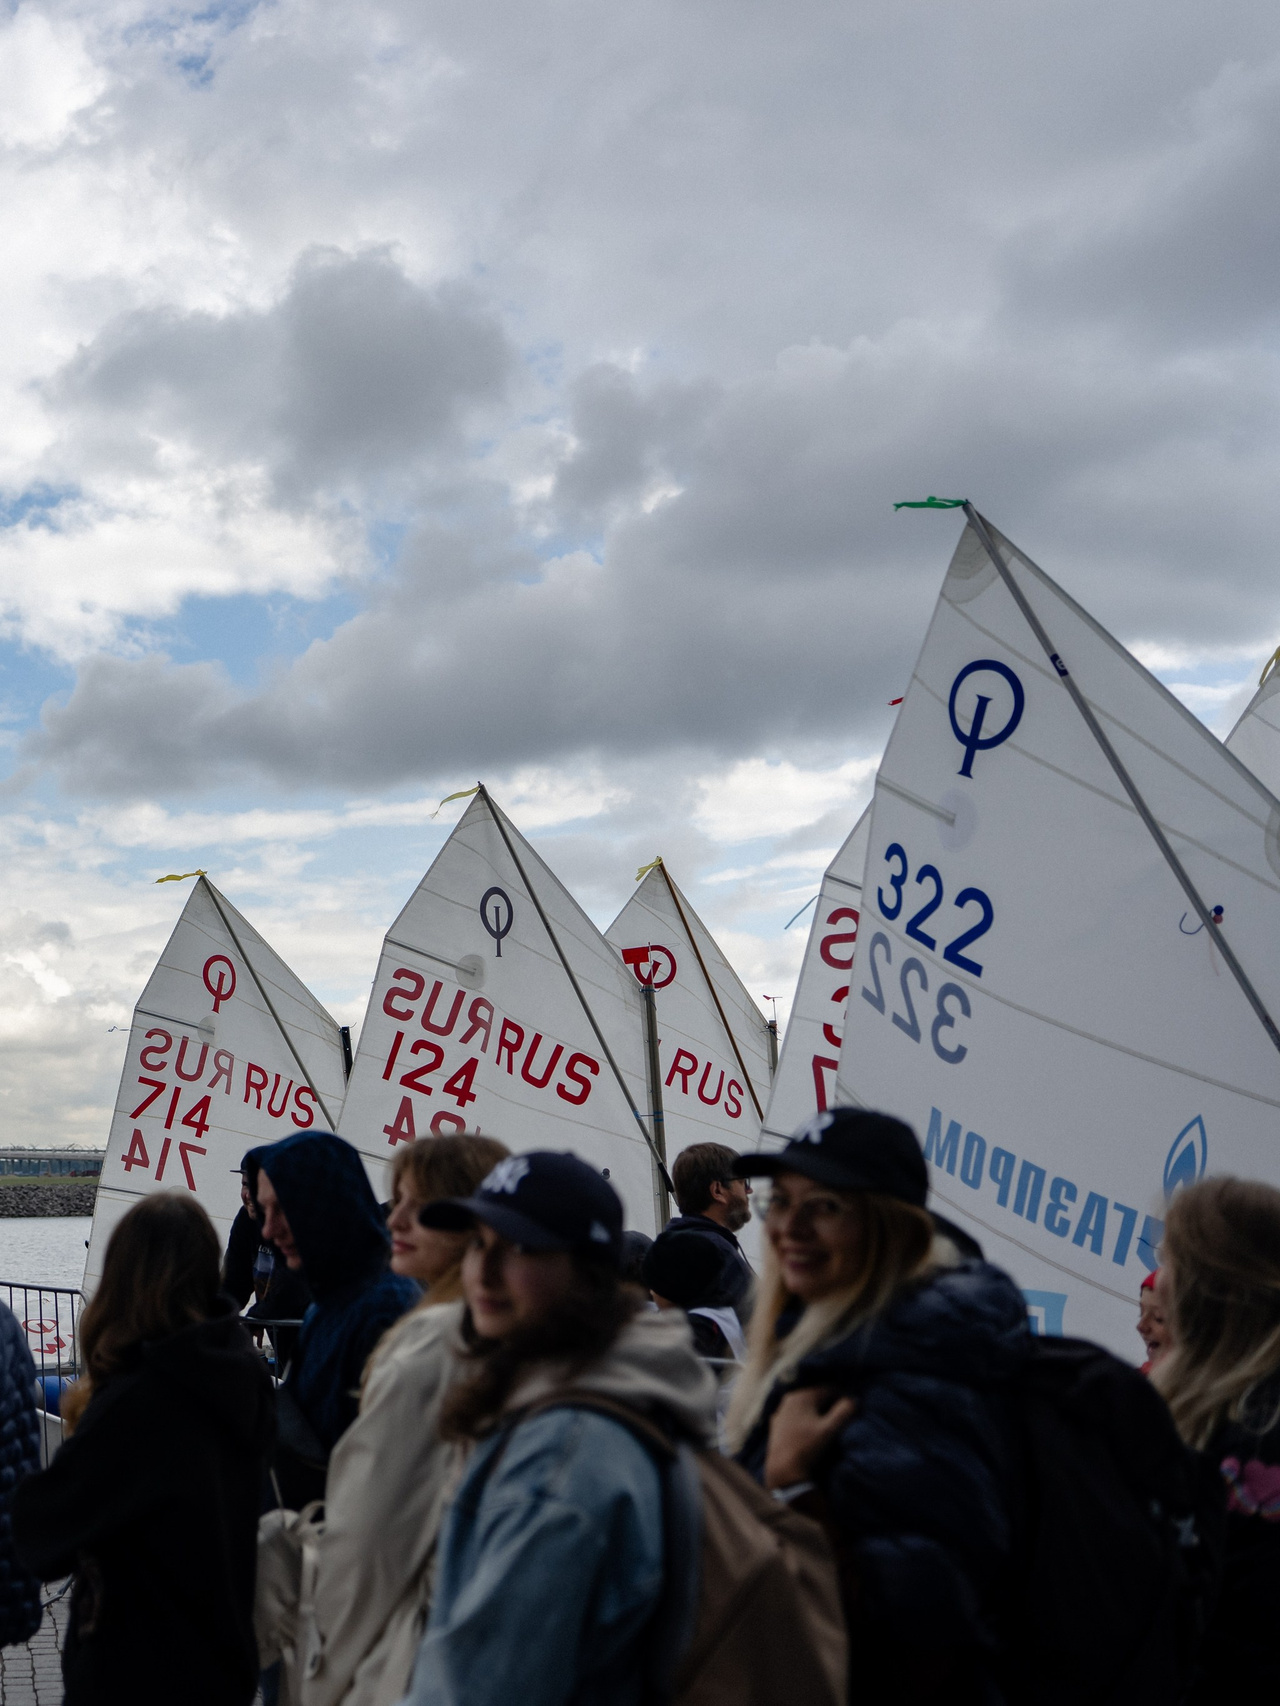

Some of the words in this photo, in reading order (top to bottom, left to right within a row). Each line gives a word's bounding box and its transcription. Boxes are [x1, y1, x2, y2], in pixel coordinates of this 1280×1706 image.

[875, 840, 995, 980] 322
[244, 1061, 318, 1129] RUS
[382, 1030, 480, 1109] 124
[496, 1016, 601, 1106] RUS
[664, 1047, 744, 1119] RUS
[130, 1075, 212, 1140] 714
